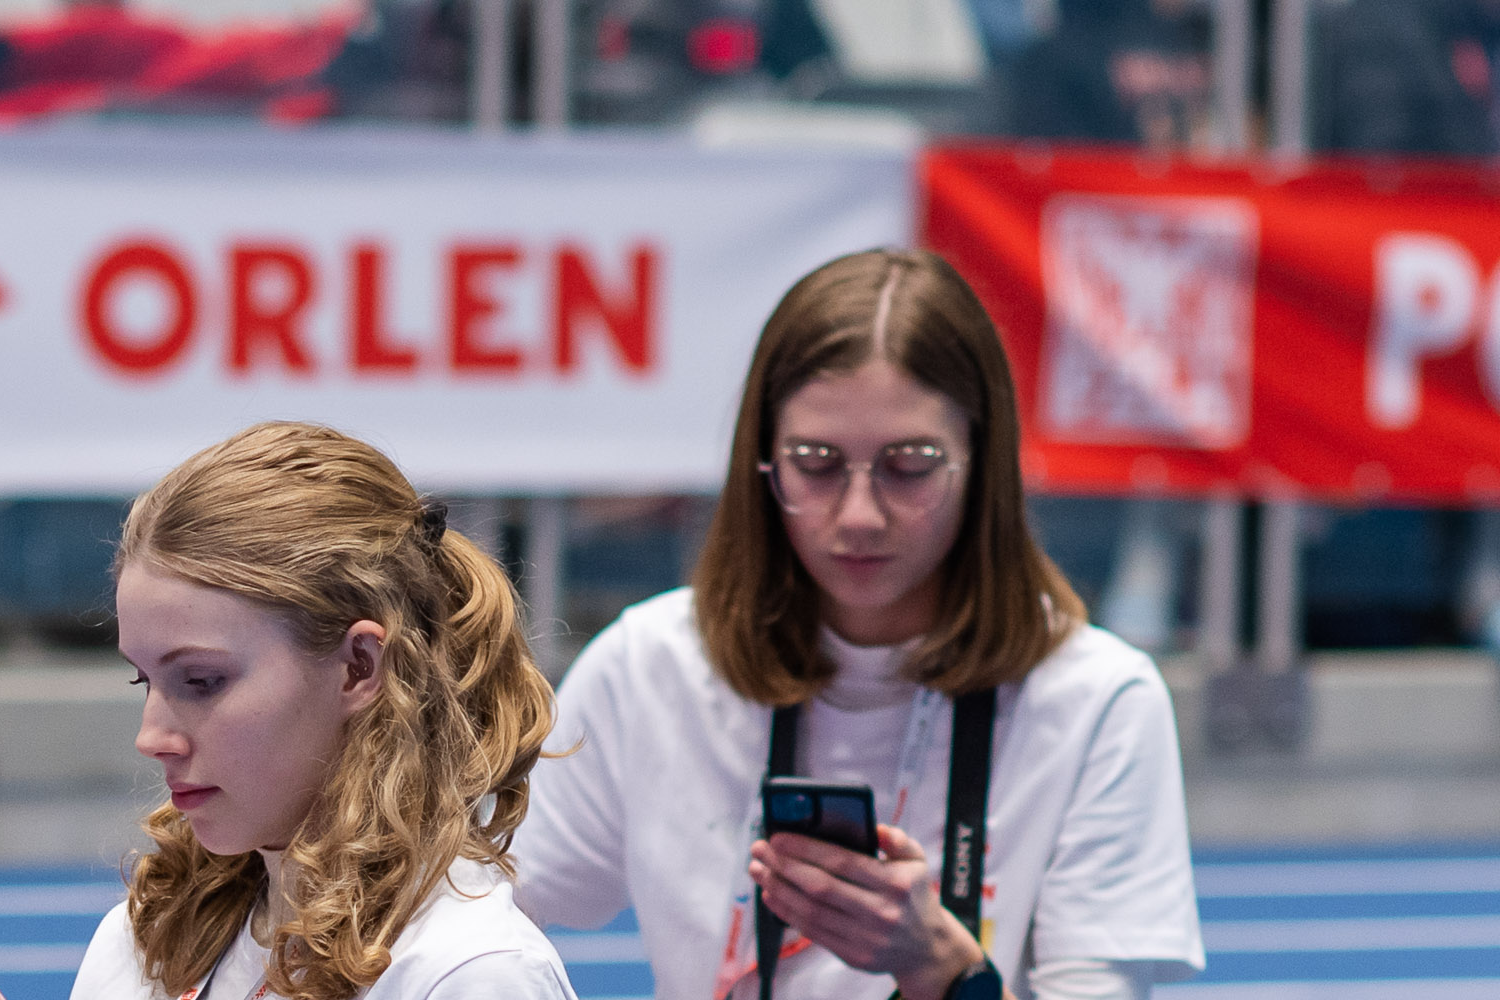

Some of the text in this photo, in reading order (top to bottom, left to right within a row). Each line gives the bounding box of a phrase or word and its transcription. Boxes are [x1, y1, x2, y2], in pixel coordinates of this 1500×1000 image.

[80, 240, 656, 376] ORLEN
[1366, 232, 1500, 430] P
[953, 822, 974, 897] SONY
